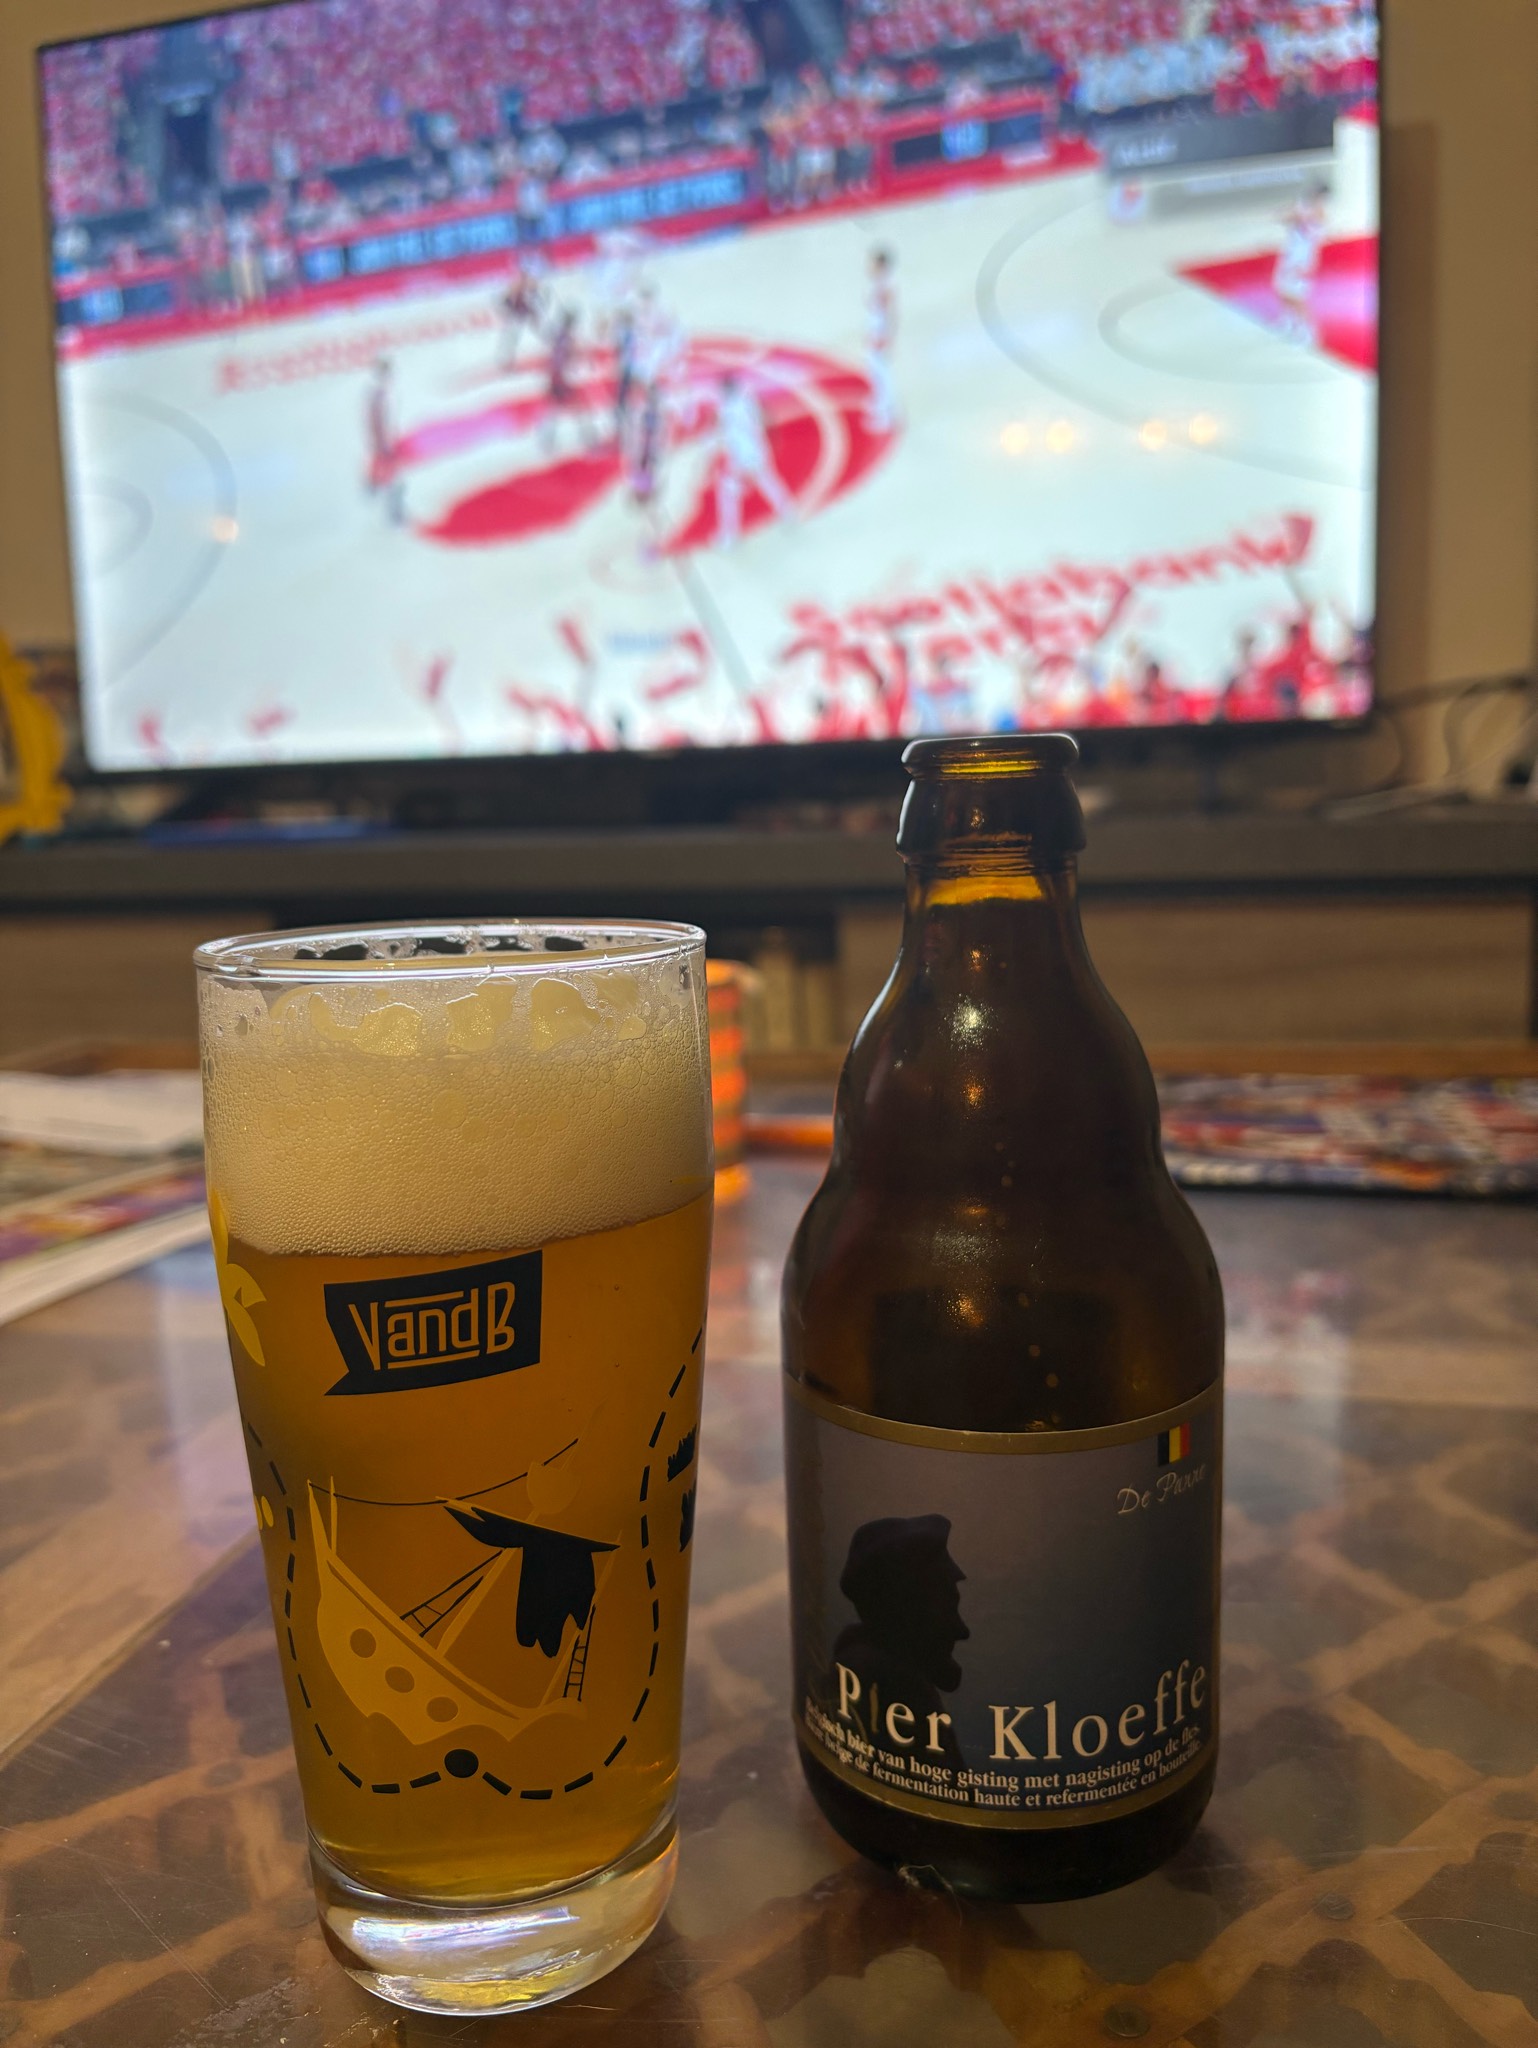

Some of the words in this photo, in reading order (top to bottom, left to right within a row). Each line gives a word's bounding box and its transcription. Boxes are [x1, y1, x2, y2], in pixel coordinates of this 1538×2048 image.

[348, 1281, 516, 1371] VandB
[1117, 1482, 1150, 1515] De
[988, 1659, 1206, 1760] Kloeffe
[847, 1728, 876, 1758] bier
[877, 1748, 906, 1770] van
[909, 1755, 952, 1783] hoge
[957, 1768, 1020, 1792] gisting
[1025, 1773, 1060, 1789] met
[1065, 1758, 1141, 1788] nagisting
[1144, 1748, 1162, 1767] op
[1164, 1738, 1180, 1757] de
[854, 1754, 871, 1773] de
[872, 1762, 970, 1802] fermentation
[974, 1789, 1020, 1807] haute
[1025, 1793, 1041, 1807] et
[1046, 1777, 1138, 1806] refermentée
[1140, 1770, 1156, 1785] en
